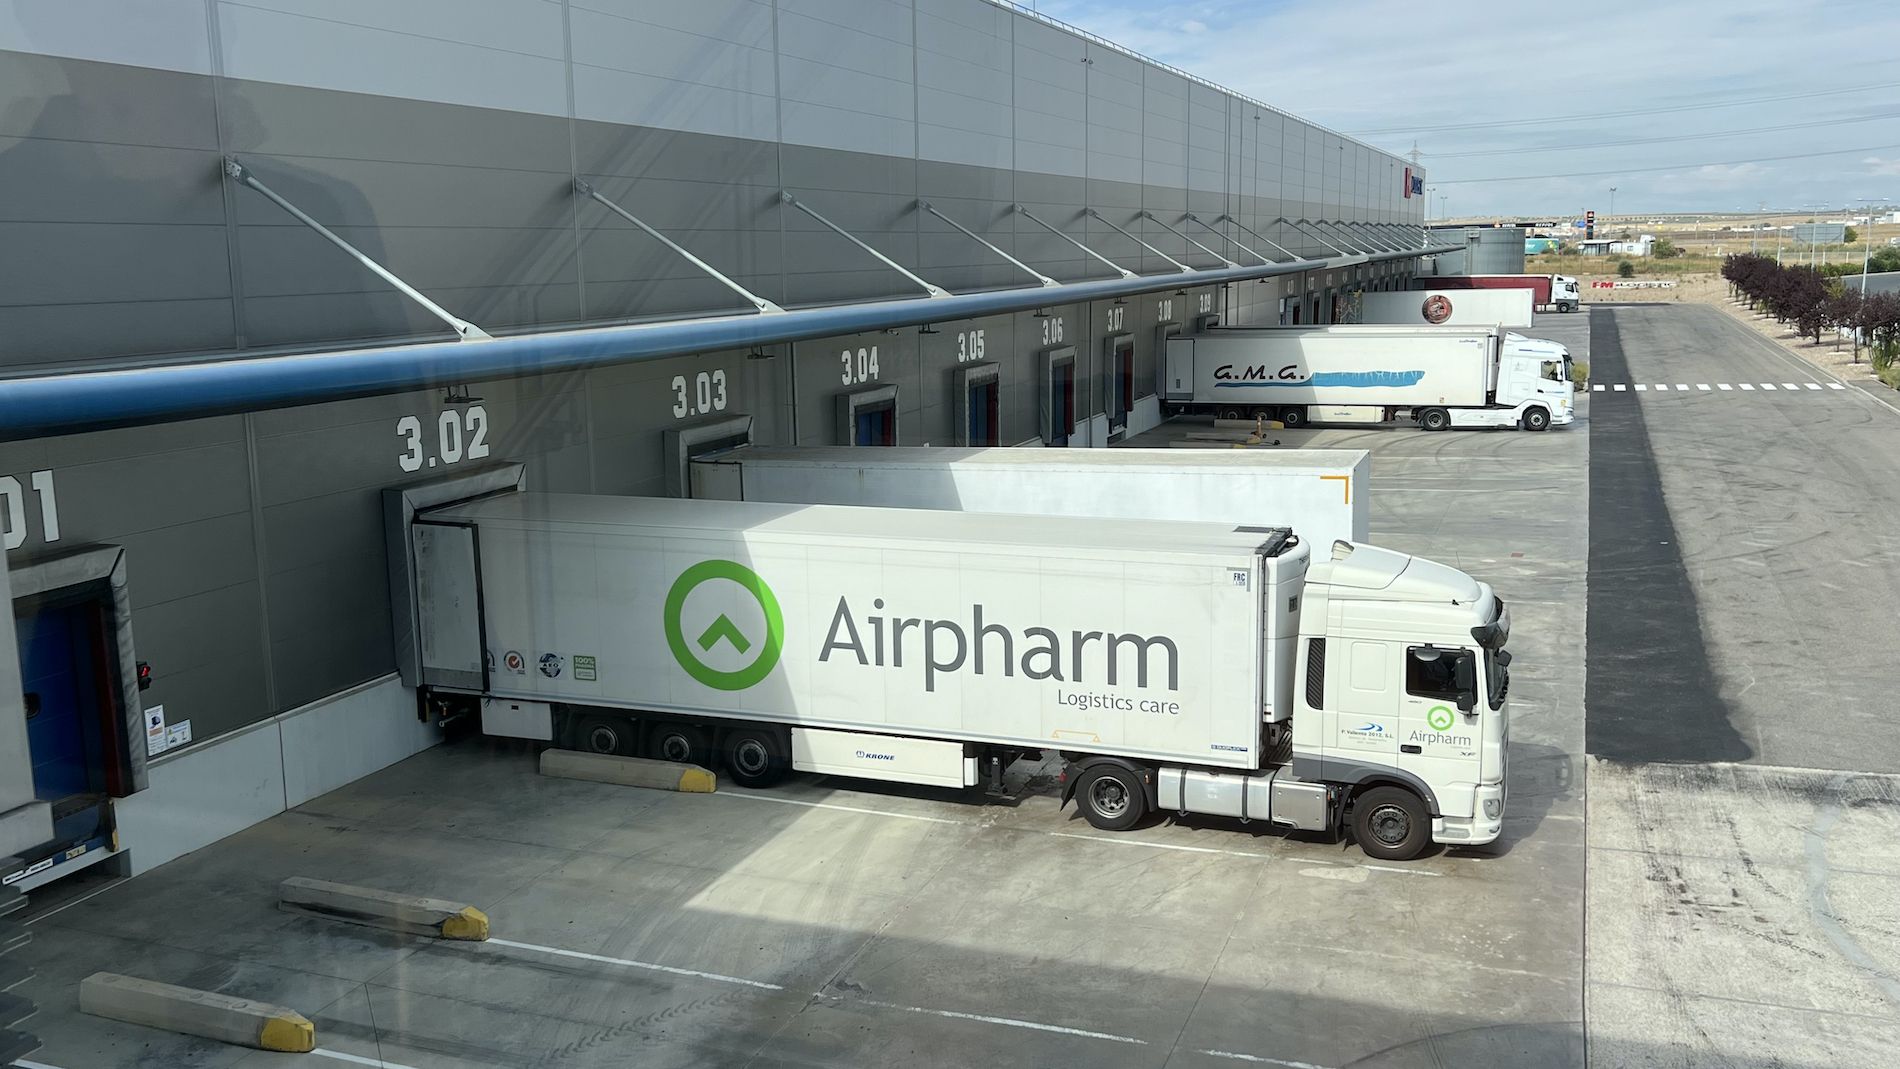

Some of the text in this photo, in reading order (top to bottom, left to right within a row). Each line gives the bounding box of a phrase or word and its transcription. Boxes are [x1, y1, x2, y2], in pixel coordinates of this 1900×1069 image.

[1042, 318, 1063, 346] 3.06
[1107, 307, 1124, 332] 3.07
[957, 329, 985, 363] 3.05
[841, 346, 880, 386] 3.04
[672, 369, 728, 419] 3.03
[397, 405, 489, 472] 3.02
[818, 595, 1179, 692] Airpharm
[1057, 689, 1180, 715] Logistics care
[1409, 730, 1471, 746] Airpharm
